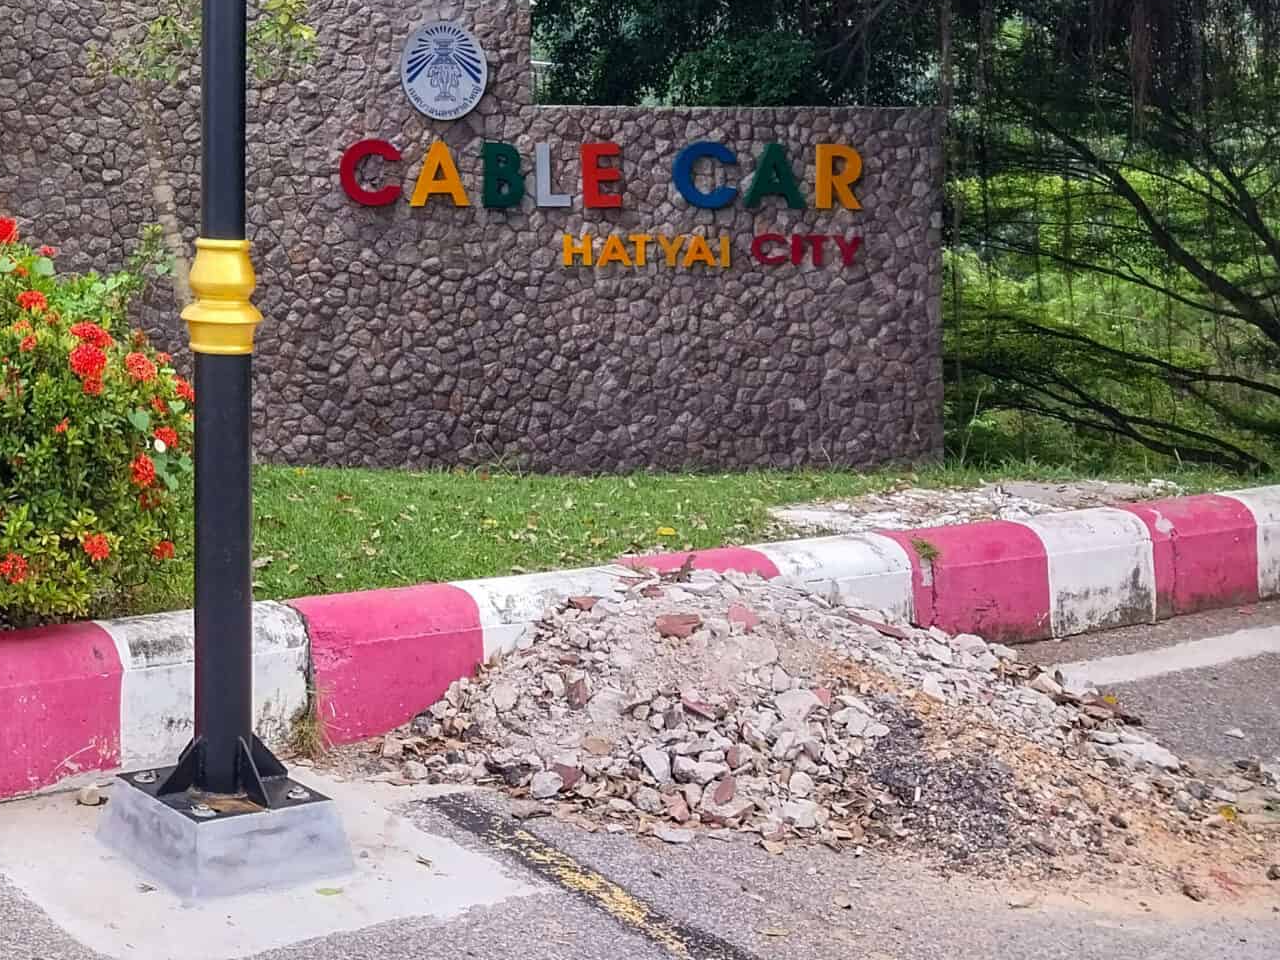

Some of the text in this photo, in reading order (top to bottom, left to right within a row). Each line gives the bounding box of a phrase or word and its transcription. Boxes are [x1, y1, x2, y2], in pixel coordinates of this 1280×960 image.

[339, 139, 864, 210] CABLE CAR
[561, 231, 864, 268] HATYAI CITY
